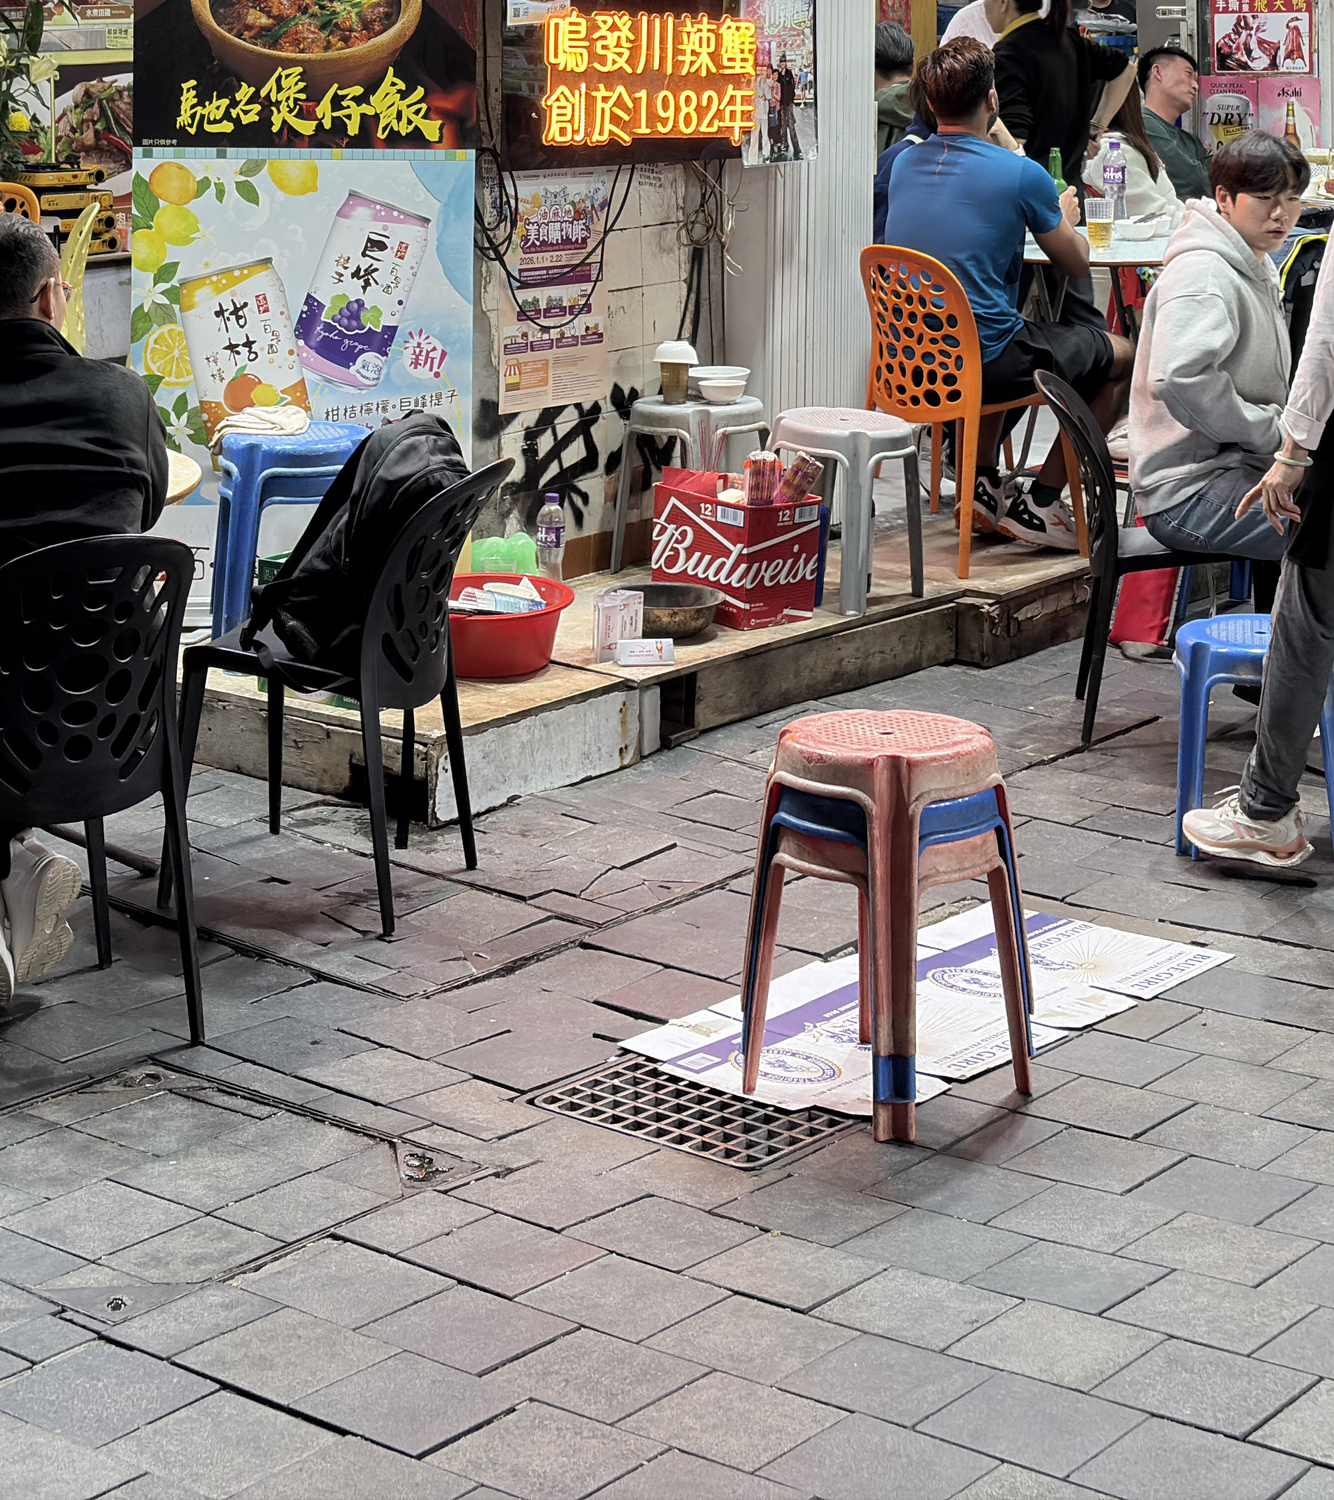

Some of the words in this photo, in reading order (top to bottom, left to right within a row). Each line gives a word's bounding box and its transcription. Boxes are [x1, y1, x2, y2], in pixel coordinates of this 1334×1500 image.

[547, 13, 756, 76] 鳴發川辣蟹
[1277, 86, 1302, 98] Asahi
[175, 66, 445, 142] 馳名煲仔飯
[545, 83, 756, 145] 創於1982年
[1103, 167, 1123, 180] vita
[539, 206, 574, 221] 油麻地
[521, 219, 590, 248] 美食購物節
[700, 503, 712, 515] 12
[778, 510, 790, 522] 12
[1169, 953, 1211, 977] BLUE
[1132, 967, 1169, 990] GIRL
[948, 1044, 989, 1072] GIRL
